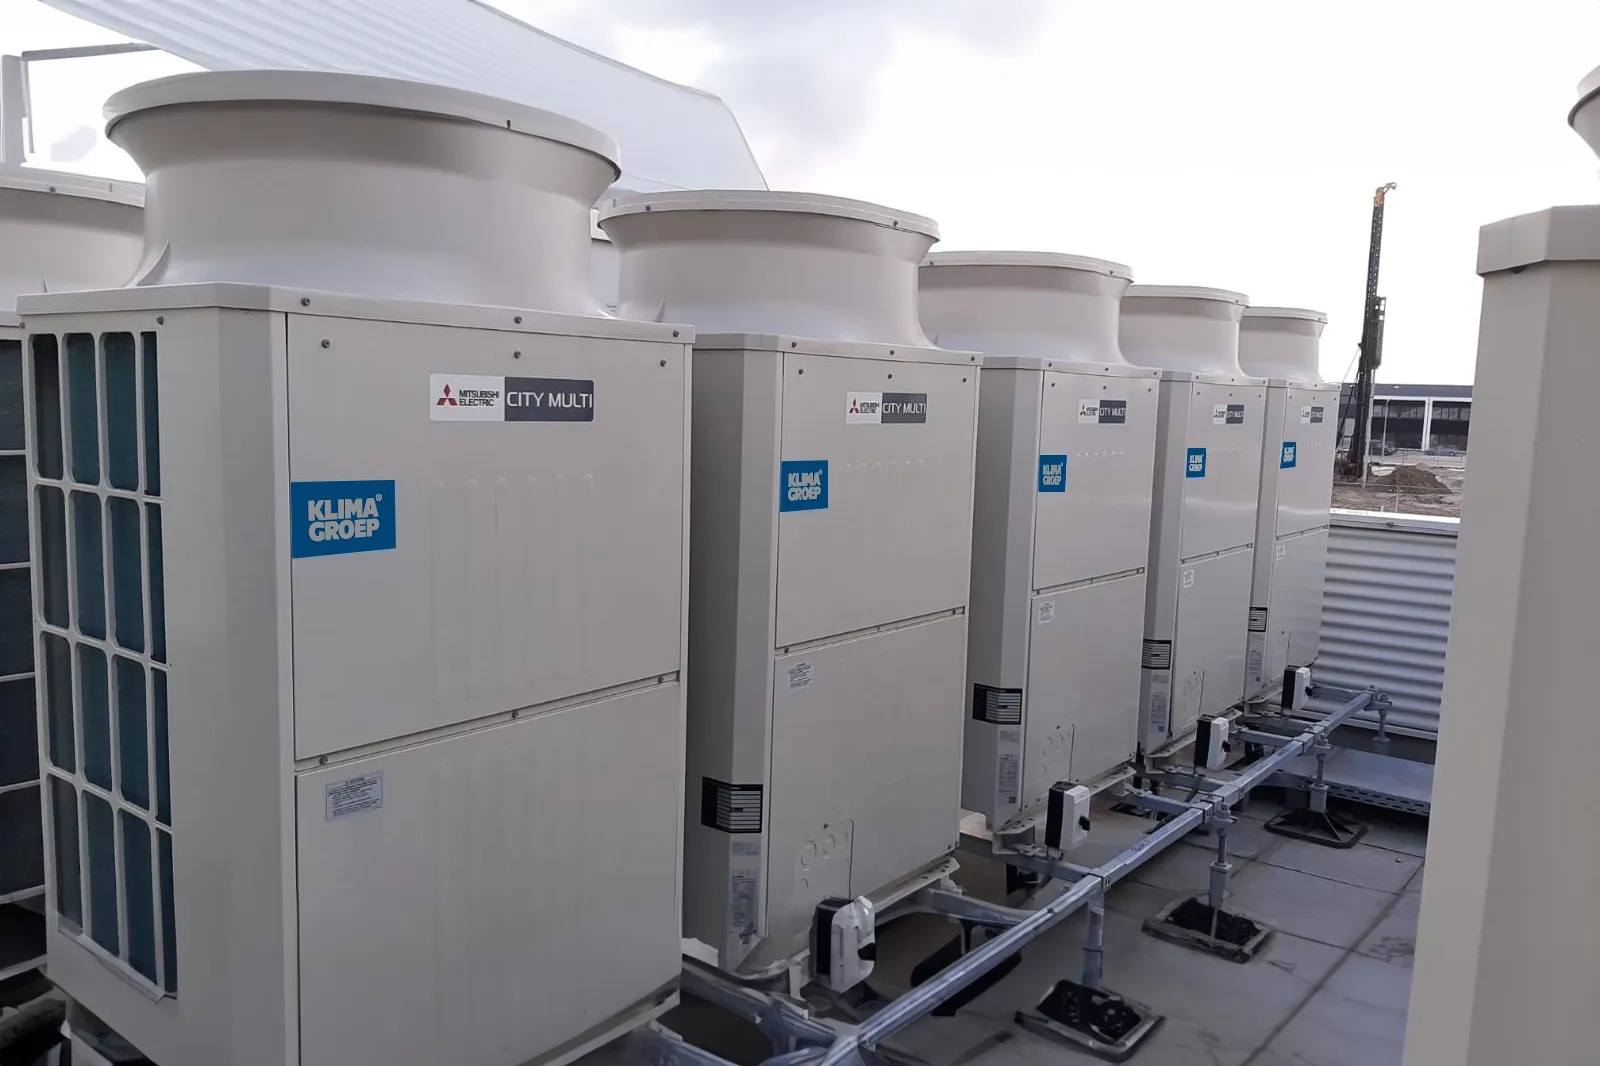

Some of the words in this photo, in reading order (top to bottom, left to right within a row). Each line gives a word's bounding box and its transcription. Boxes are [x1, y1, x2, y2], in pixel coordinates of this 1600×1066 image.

[459, 389, 499, 398] MITSUBISHI
[507, 392, 544, 407] CITY
[548, 393, 593, 408] MULTI
[459, 398, 495, 407] ELECTRIC
[882, 402, 902, 414] CITY
[903, 402, 926, 414] MULTI
[787, 486, 822, 502] GROEP
[308, 518, 380, 542] GROEP
